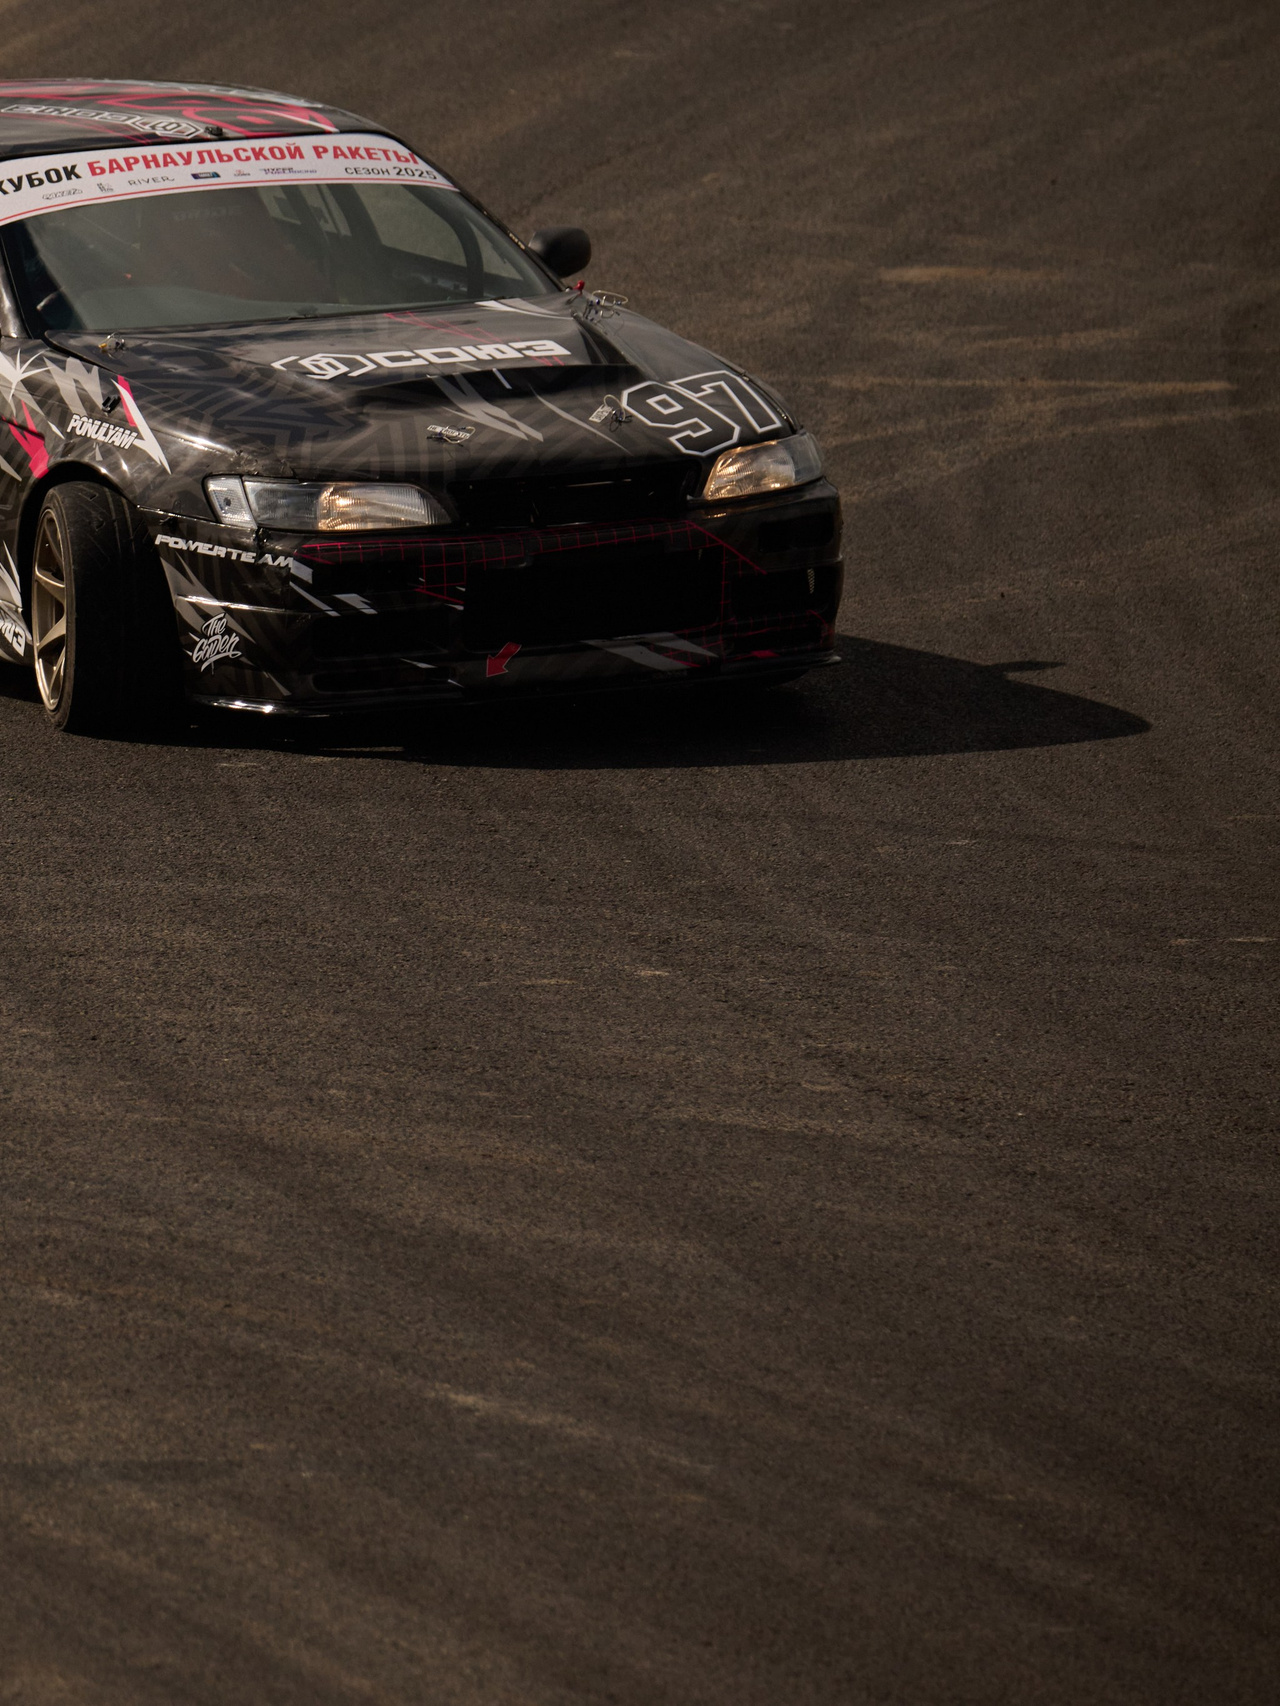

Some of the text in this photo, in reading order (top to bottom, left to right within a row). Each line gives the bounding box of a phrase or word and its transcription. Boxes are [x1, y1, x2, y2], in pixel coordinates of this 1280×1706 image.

[87, 142, 305, 177] БАРНАУЛЬСКОЙ
[312, 145, 420, 166] РАКЕТЫ
[128, 175, 175, 187] RIVER
[344, 165, 438, 181] СЕЗОН 2025
[621, 369, 783, 457] 97
